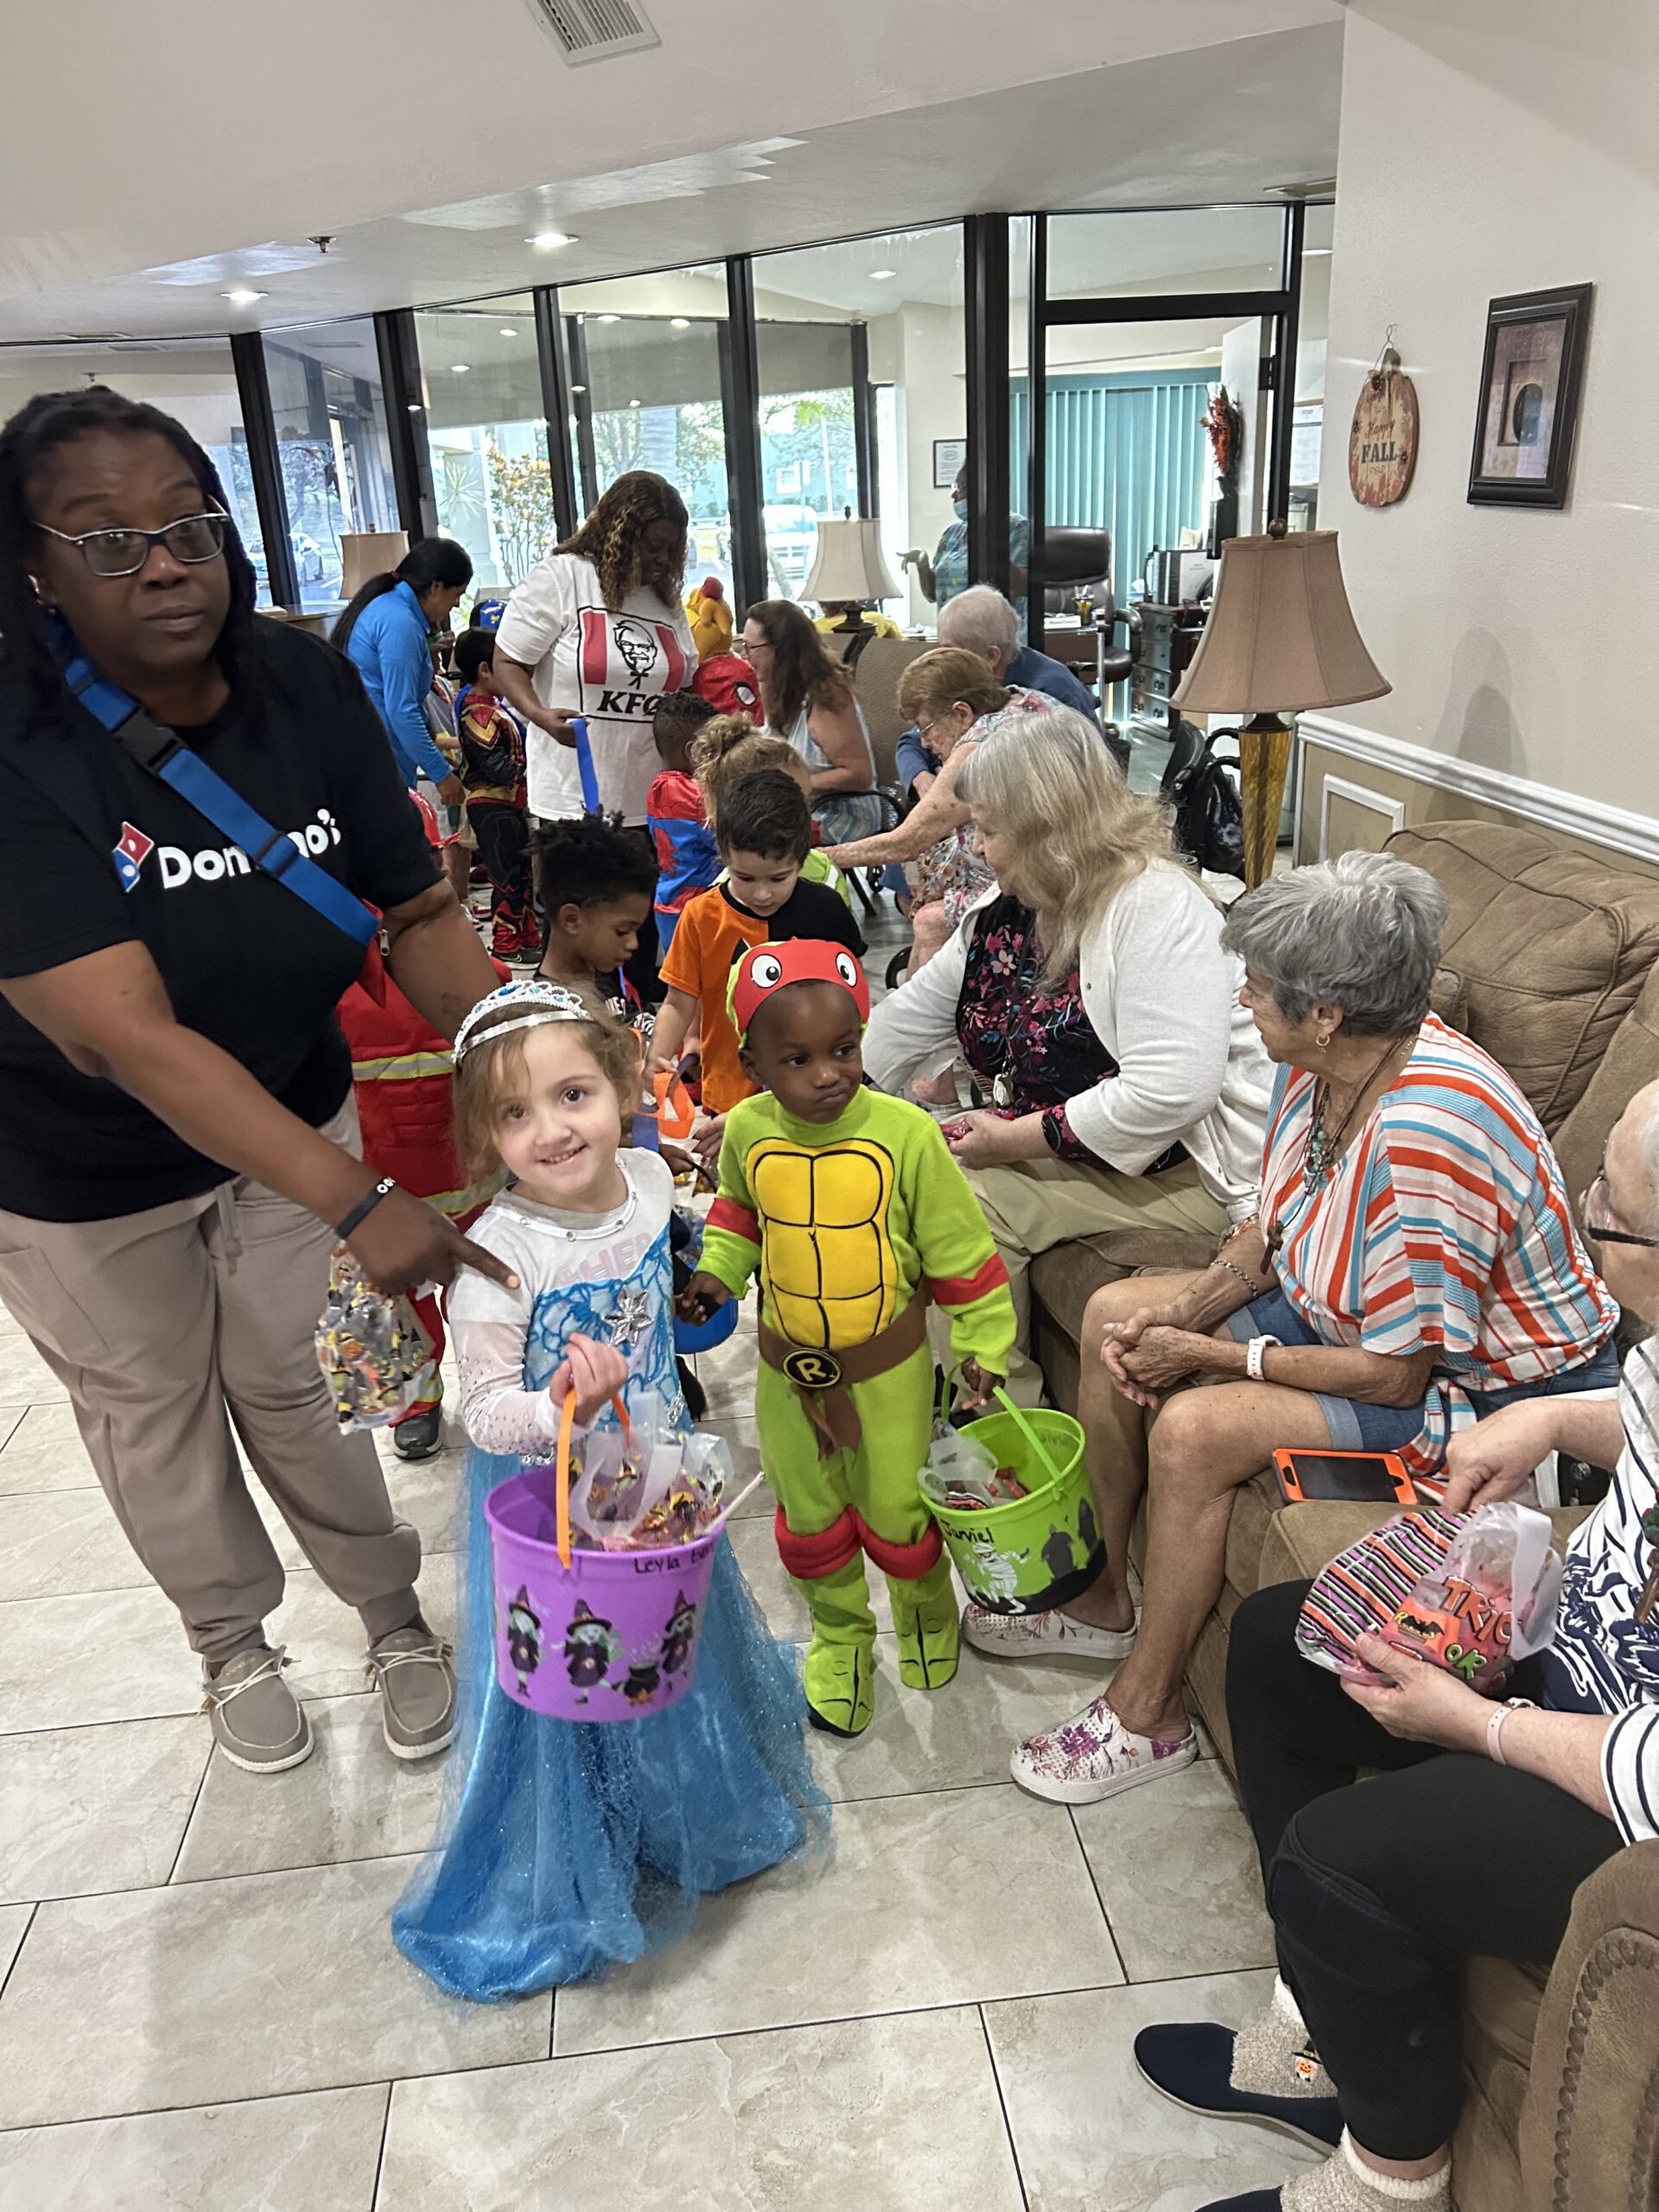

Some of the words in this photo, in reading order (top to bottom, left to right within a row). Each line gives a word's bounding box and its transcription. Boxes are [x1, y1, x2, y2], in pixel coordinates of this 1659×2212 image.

[1361, 442, 1397, 464] FALL
[796, 1357, 827, 1382] R
[633, 1554, 681, 1573] Leyla
[1445, 1643, 1489, 1681] OR
